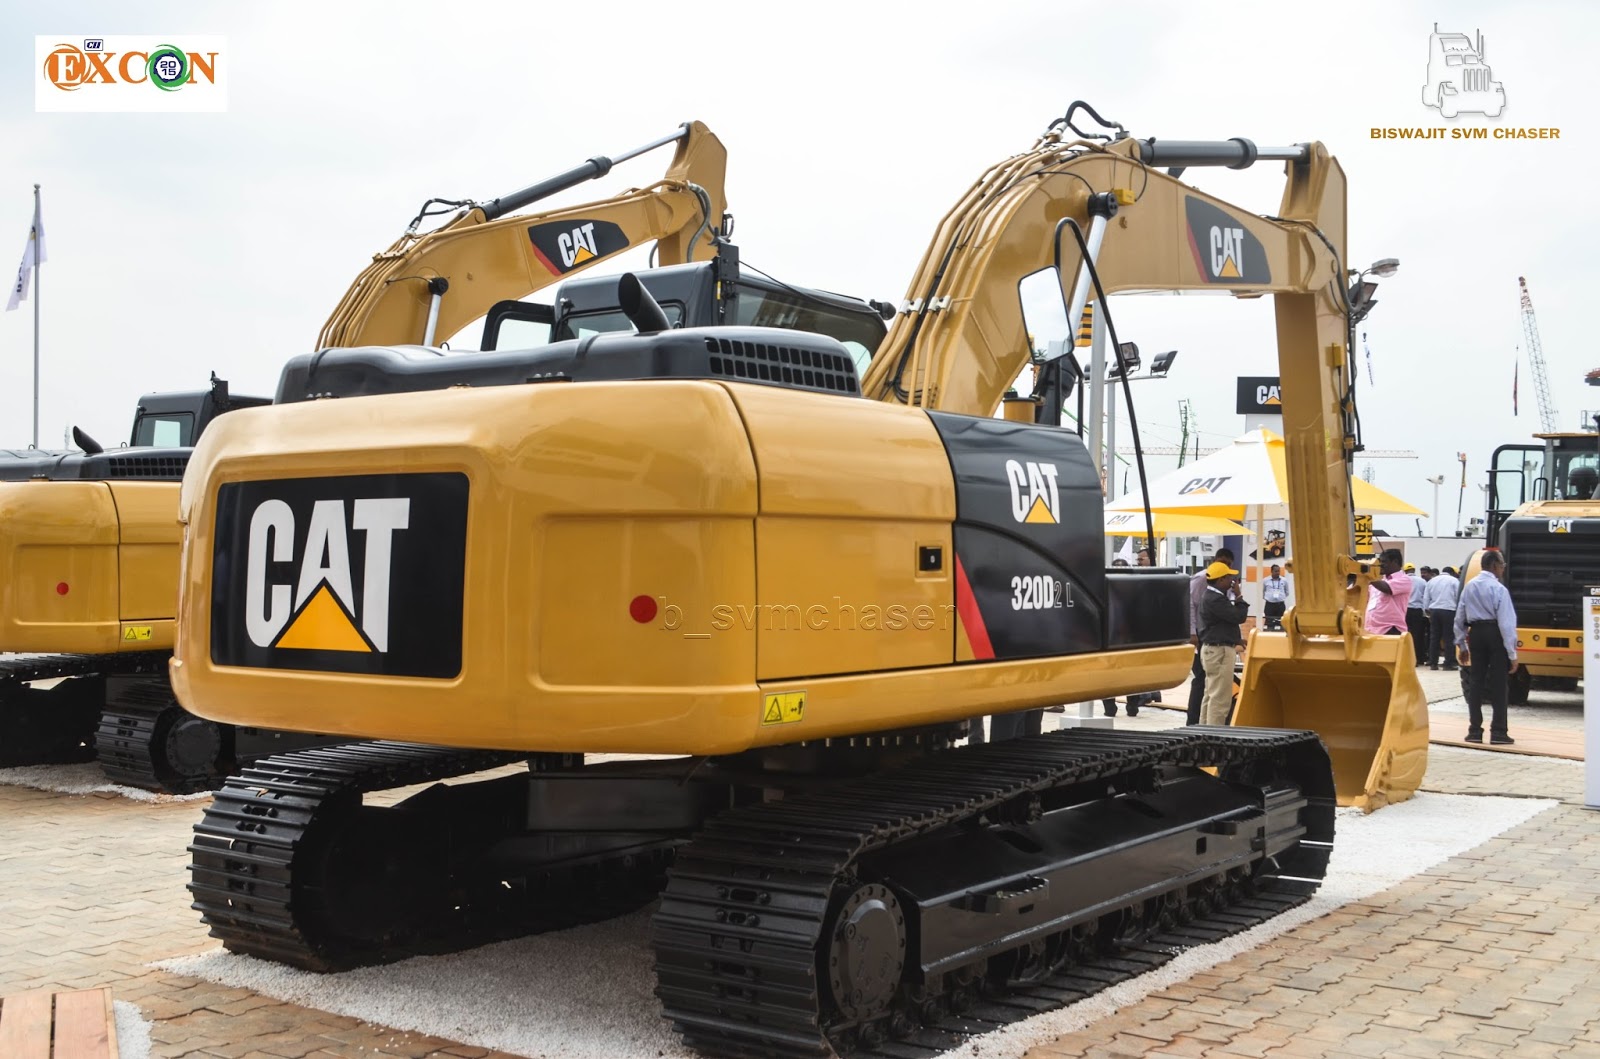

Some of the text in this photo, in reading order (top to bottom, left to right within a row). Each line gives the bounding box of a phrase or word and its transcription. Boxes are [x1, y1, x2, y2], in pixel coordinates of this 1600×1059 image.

[557, 222, 598, 268] CAT
[1210, 225, 1244, 278] CAT
[1256, 385, 1281, 405] CA
[1006, 459, 1060, 524] CAT
[1178, 476, 1232, 495] CAT
[1106, 514, 1135, 526] CAT
[1548, 519, 1574, 533] CAT
[245, 497, 411, 653] CAT
